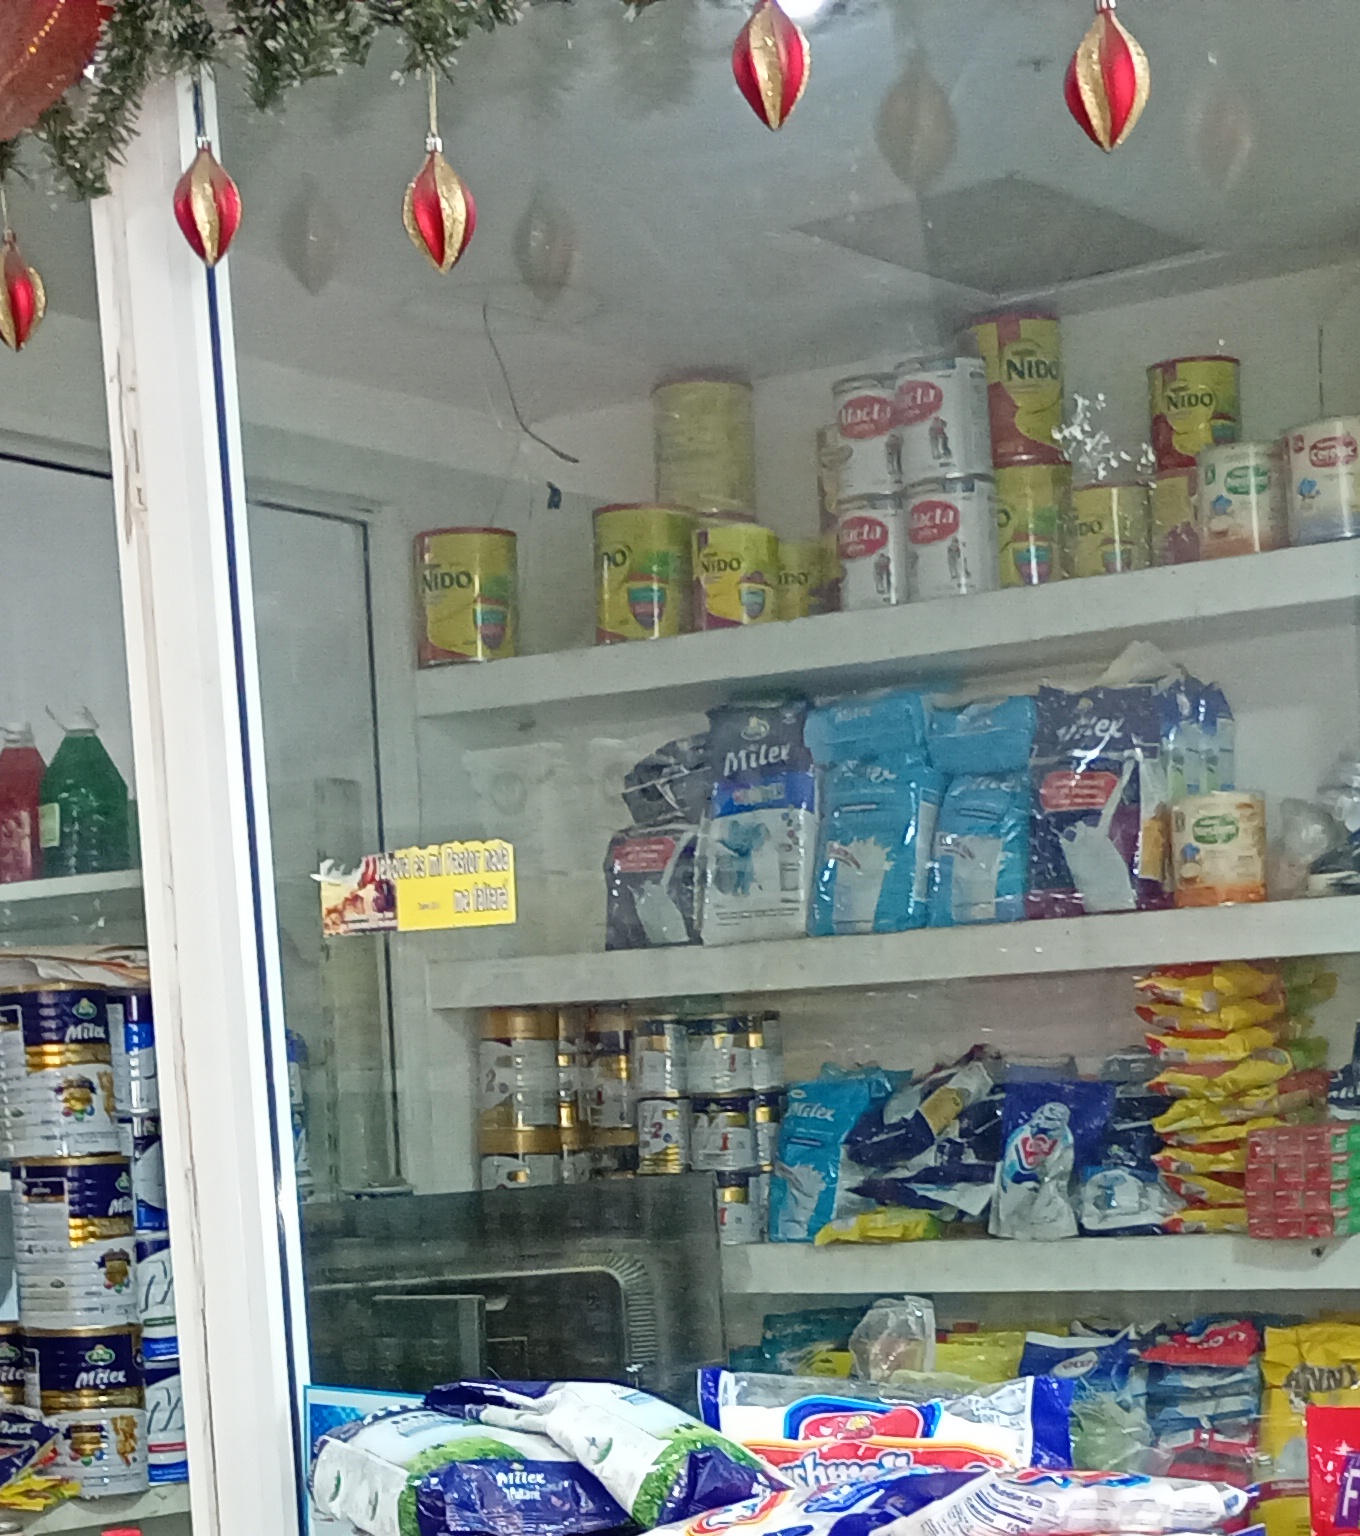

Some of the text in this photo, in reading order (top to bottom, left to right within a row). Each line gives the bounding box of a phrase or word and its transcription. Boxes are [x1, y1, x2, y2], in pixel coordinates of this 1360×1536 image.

[1166, 390, 1214, 410] NIDO
[701, 556, 742, 573] NIDO
[422, 571, 473, 593] NIDO
[723, 740, 791, 777] Milex
[787, 1102, 835, 1123] Milex
